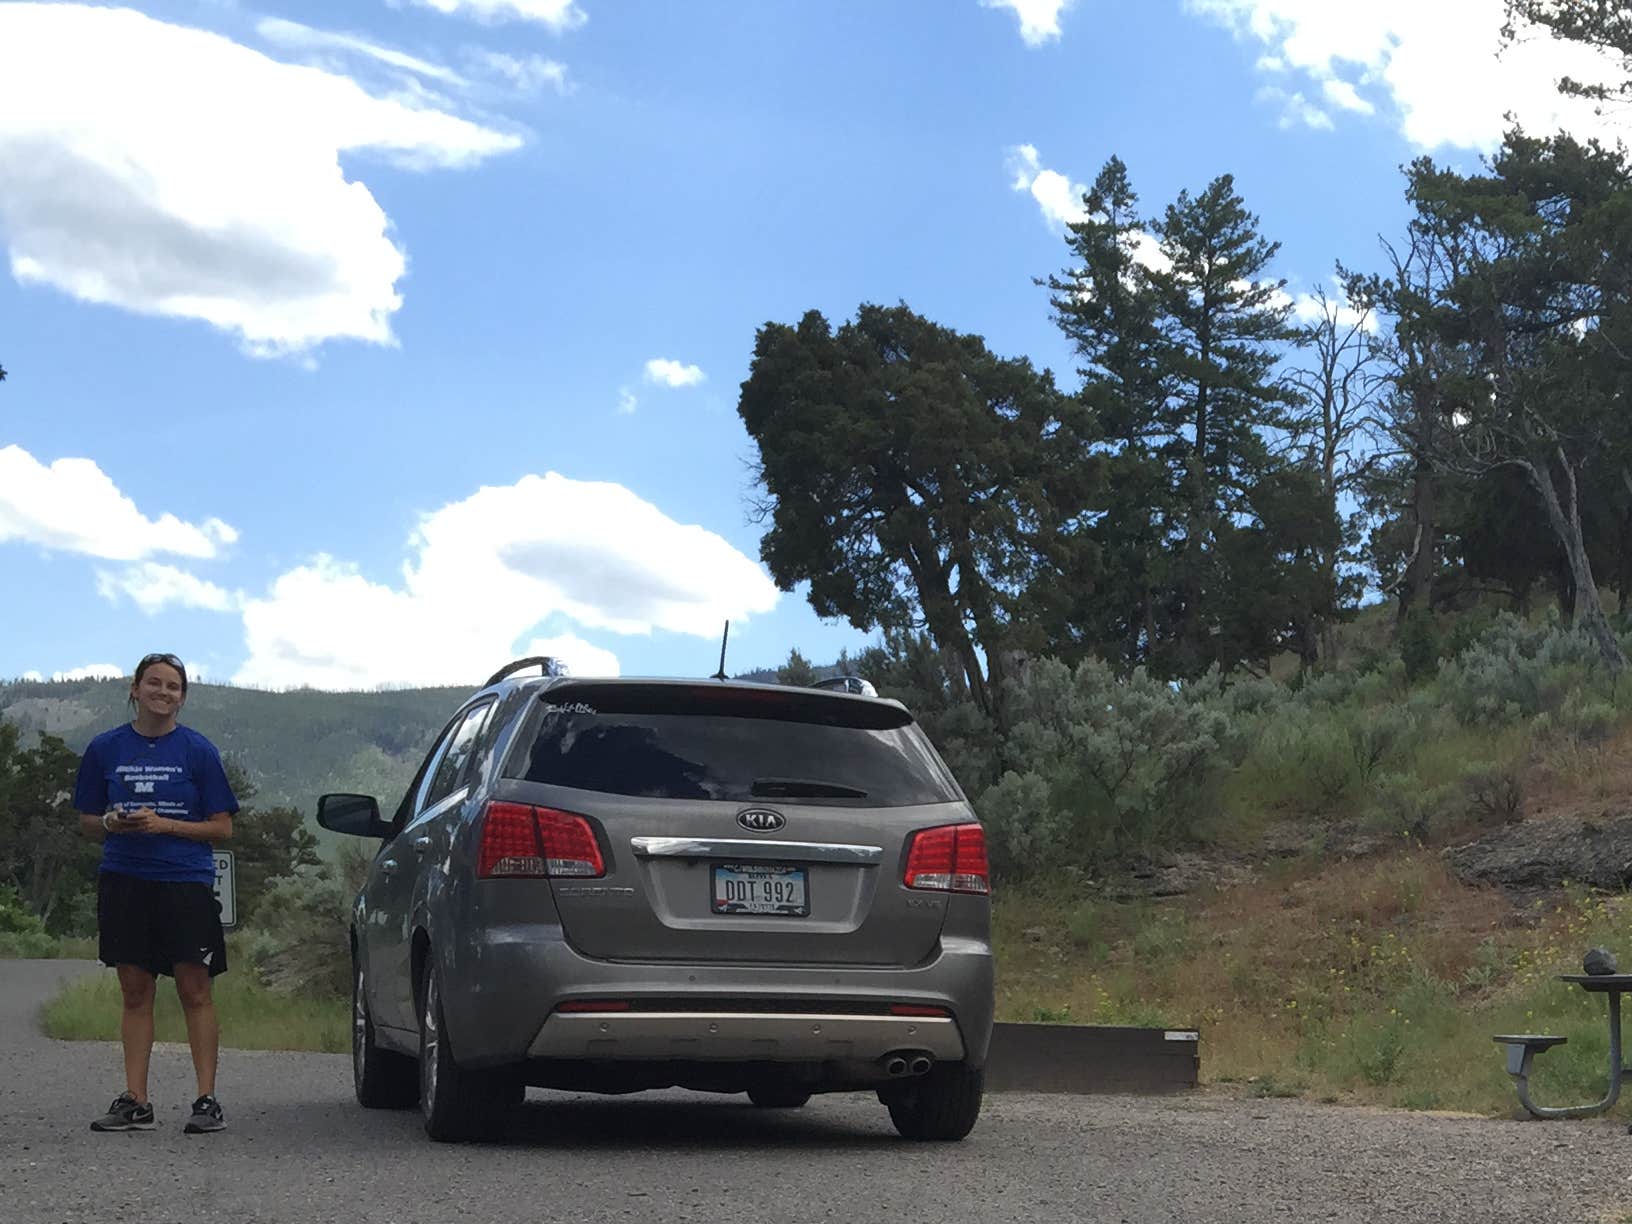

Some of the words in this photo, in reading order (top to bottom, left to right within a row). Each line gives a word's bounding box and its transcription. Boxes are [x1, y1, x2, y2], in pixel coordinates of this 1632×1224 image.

[134, 782, 155, 793] M
[745, 814, 777, 827] KIA
[725, 880, 757, 902] DDT
[764, 881, 794, 903] 992
